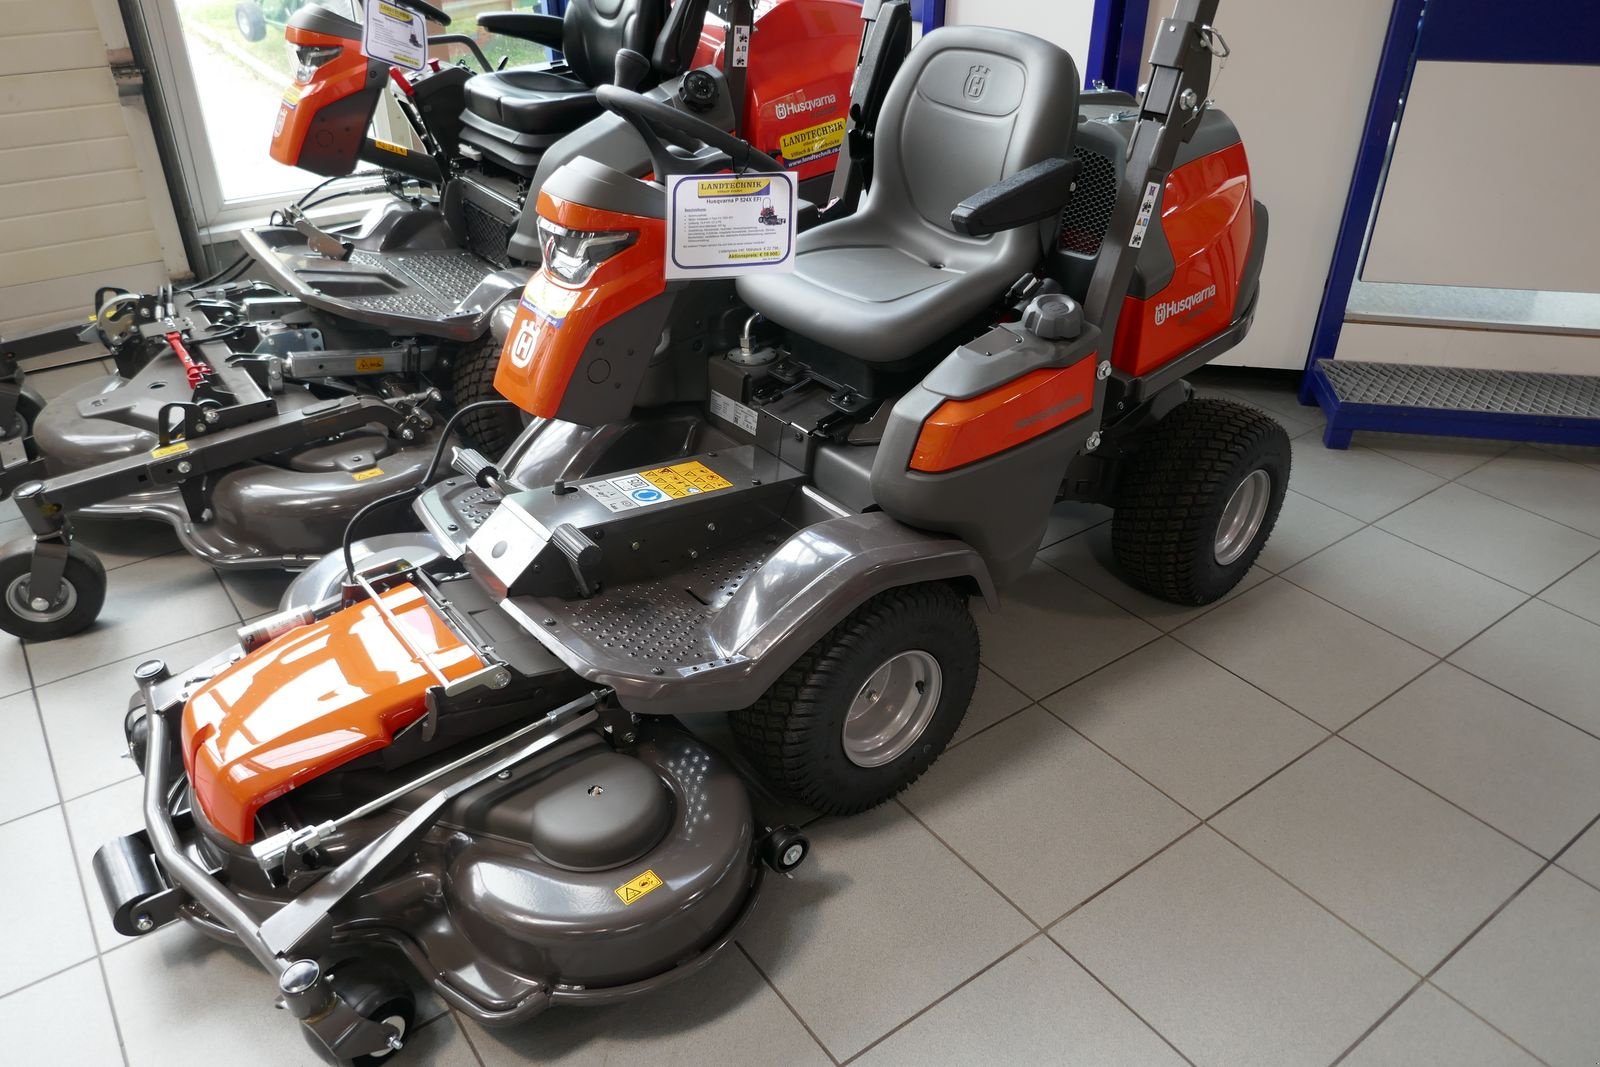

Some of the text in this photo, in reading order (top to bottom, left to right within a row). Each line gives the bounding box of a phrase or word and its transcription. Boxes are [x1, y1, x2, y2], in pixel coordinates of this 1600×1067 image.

[786, 94, 837, 115] Husqvarna
[783, 121, 844, 148] LANDTECHNIK
[701, 181, 762, 190] LANDTECHNIK
[1166, 284, 1216, 318] Husqvarna
